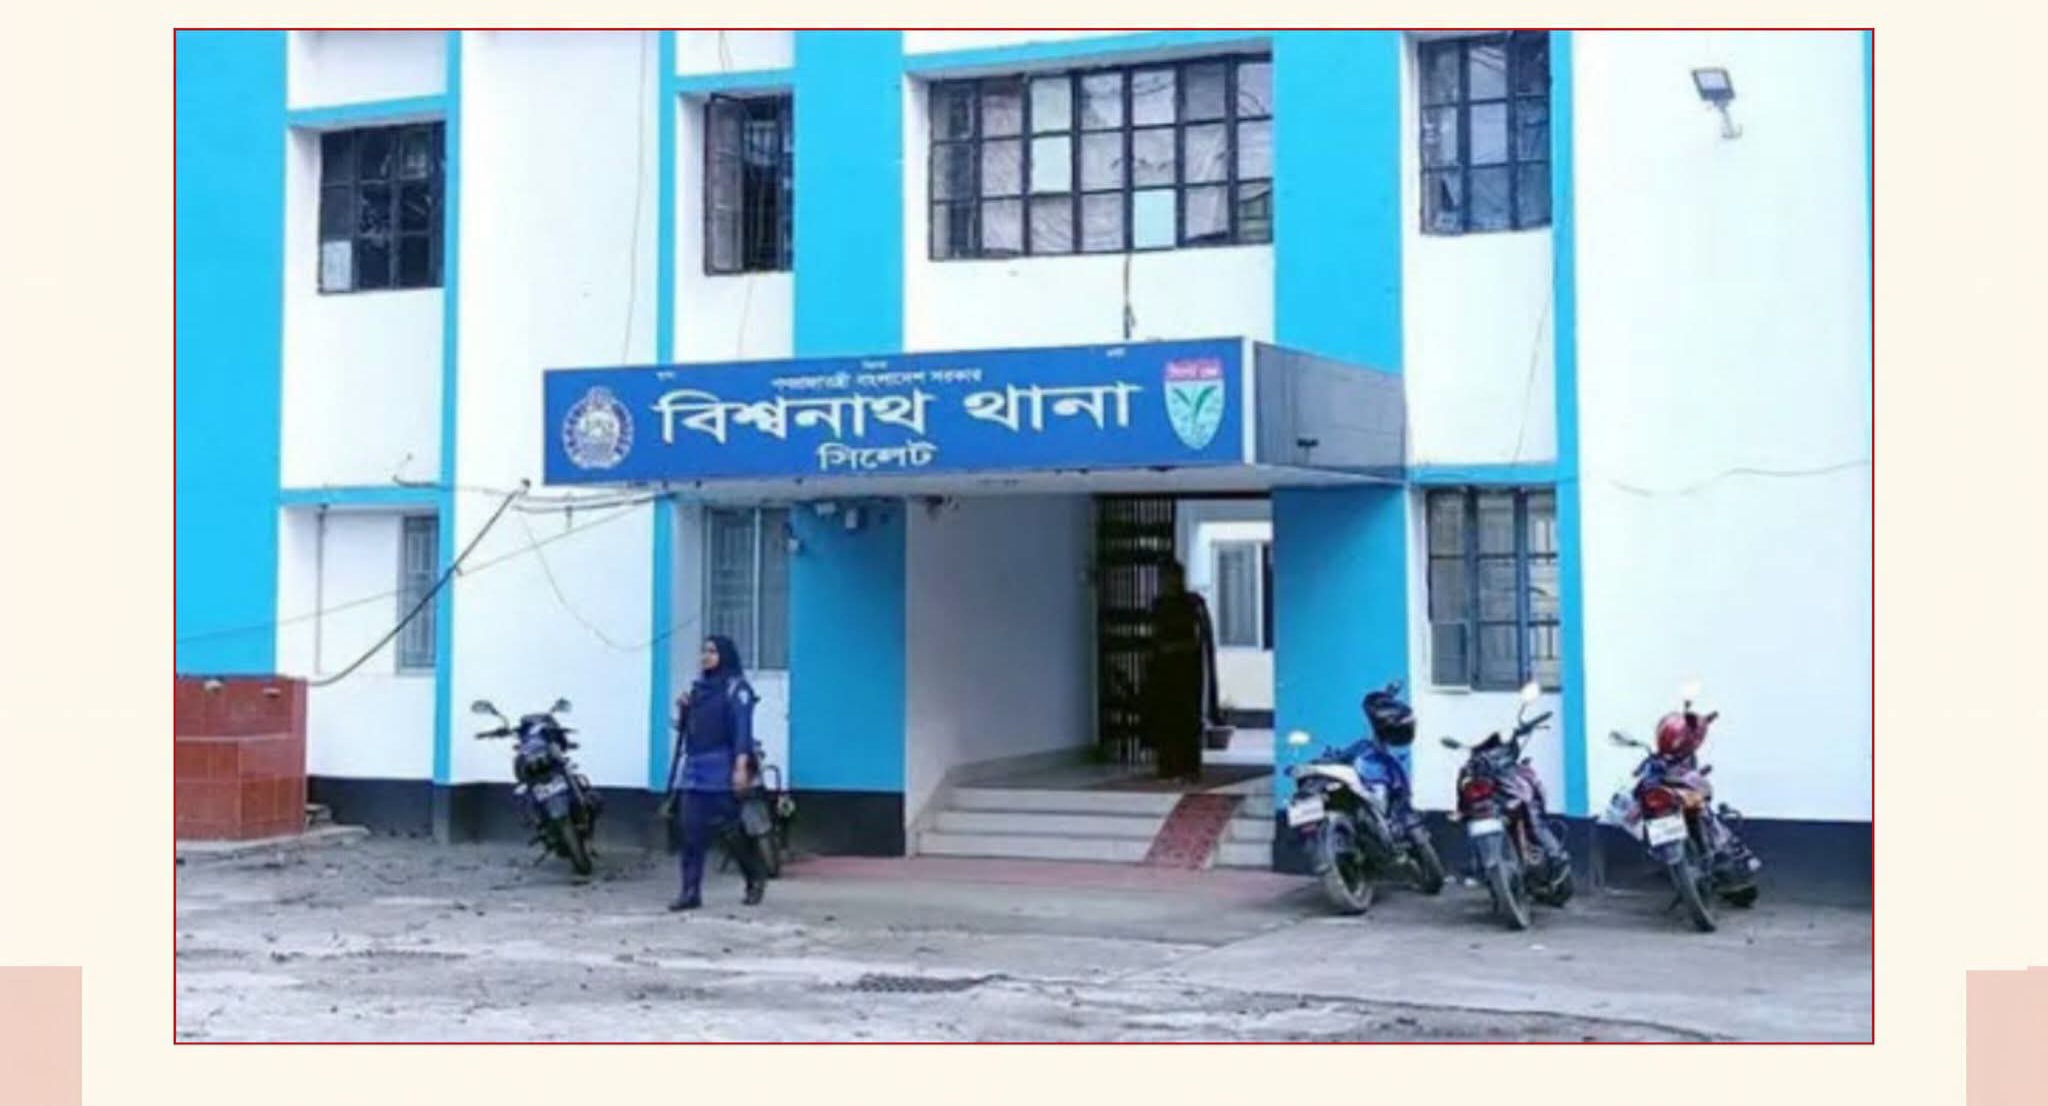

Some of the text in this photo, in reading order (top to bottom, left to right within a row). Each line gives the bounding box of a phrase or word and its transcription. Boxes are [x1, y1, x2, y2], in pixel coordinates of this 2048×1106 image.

[650, 380, 1143, 444] বিশ্বনাথ থানা
[817, 438, 936, 471] সিলেট
